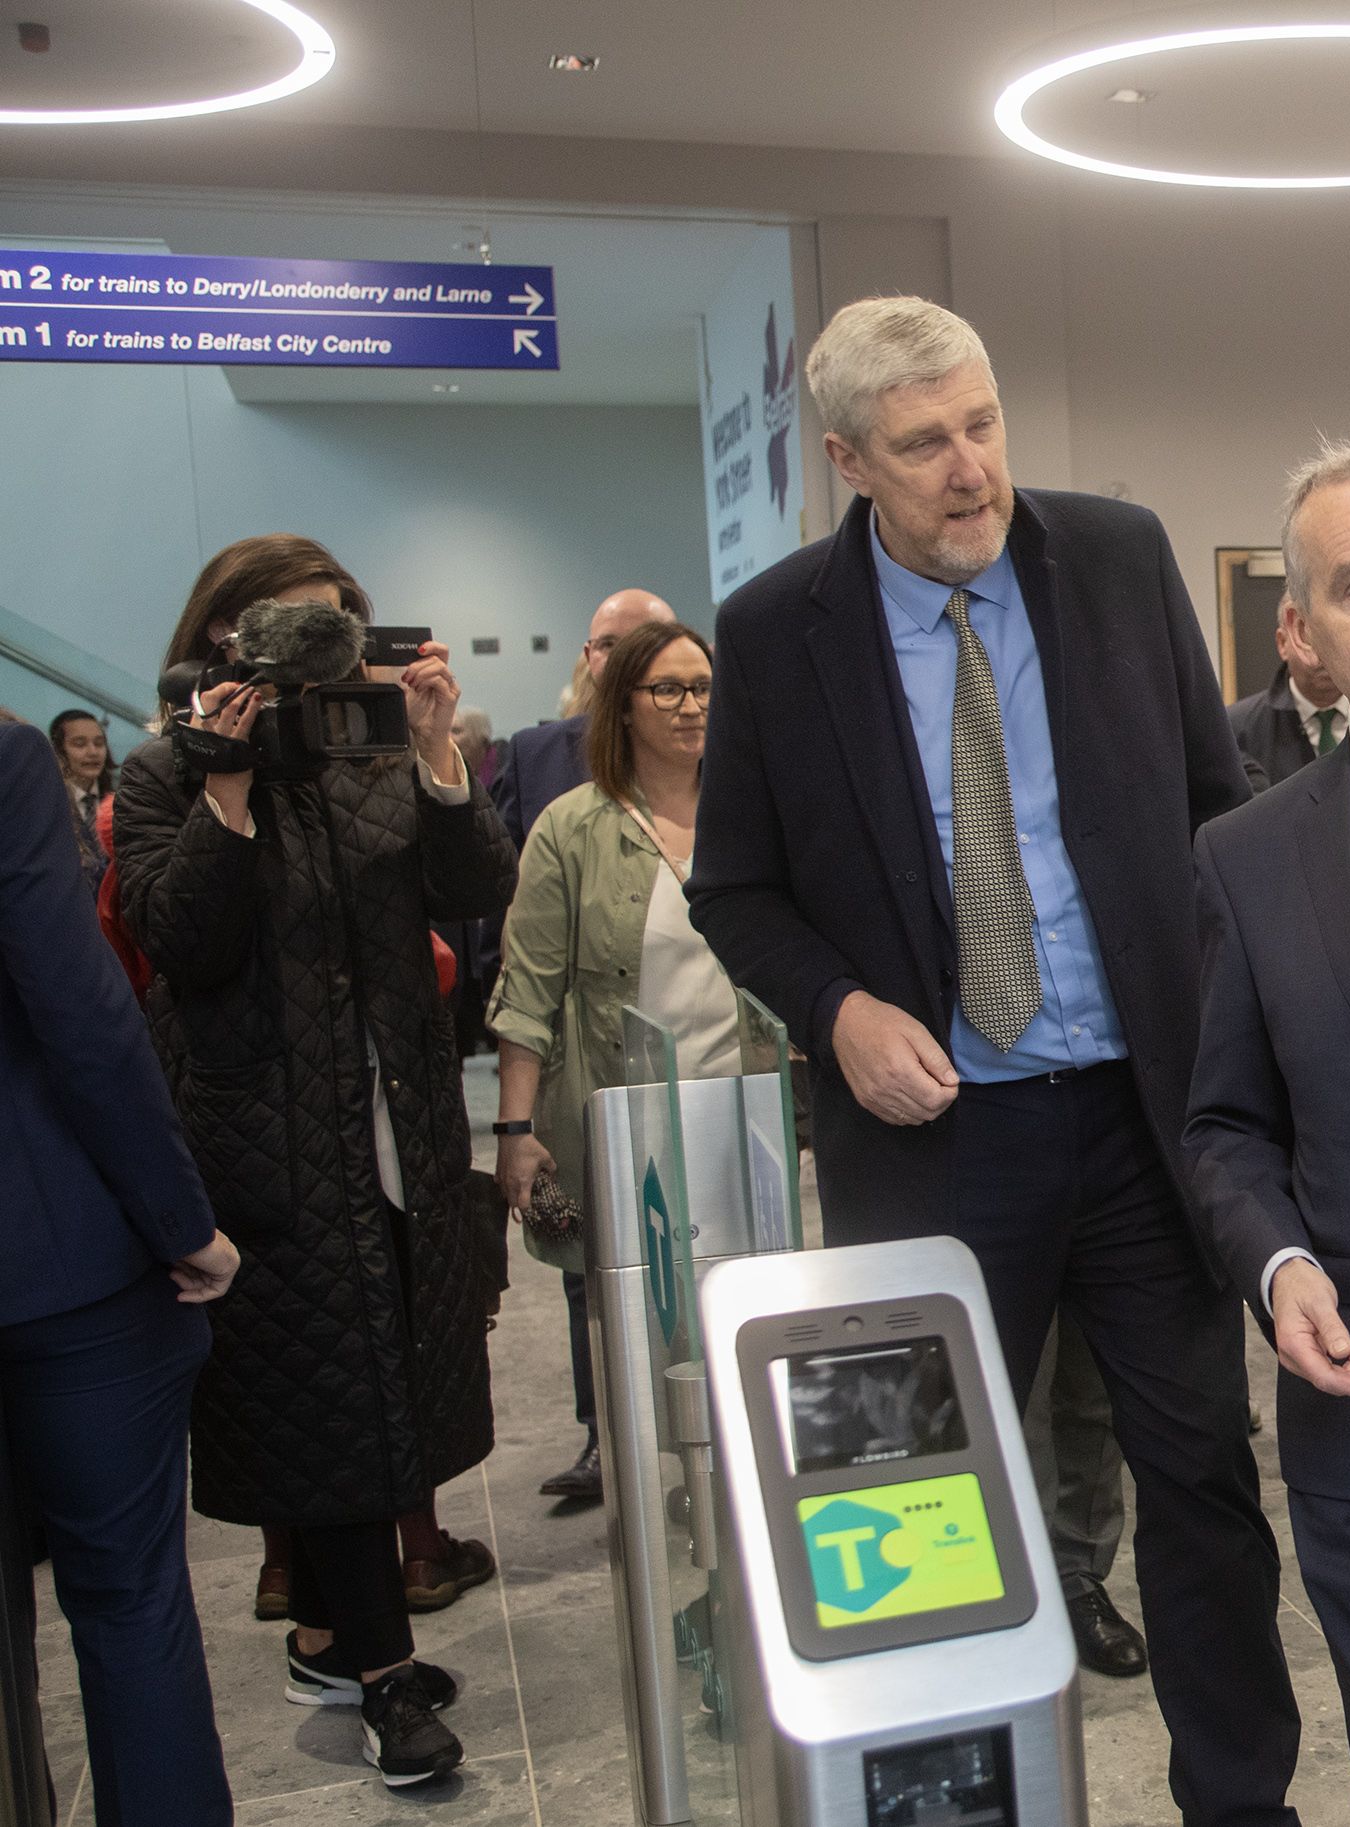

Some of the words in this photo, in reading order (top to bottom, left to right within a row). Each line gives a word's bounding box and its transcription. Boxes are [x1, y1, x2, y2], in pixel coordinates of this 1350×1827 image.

[29, 265, 52, 291] 2
[61, 274, 94, 292] for
[98, 275, 160, 294] trains
[166, 277, 188, 295] to
[193, 277, 389, 304] Derry/Londonderry
[393, 284, 430, 302] and
[436, 285, 492, 304] Larne
[34, 322, 51, 346] 1
[66, 329, 98, 348] for
[103, 331, 164, 349] trains
[170, 333, 192, 350] to
[198, 333, 271, 352] Belfast
[276, 334, 318, 356] City
[322, 335, 392, 354] Centre
[815, 1526, 877, 1592] T
